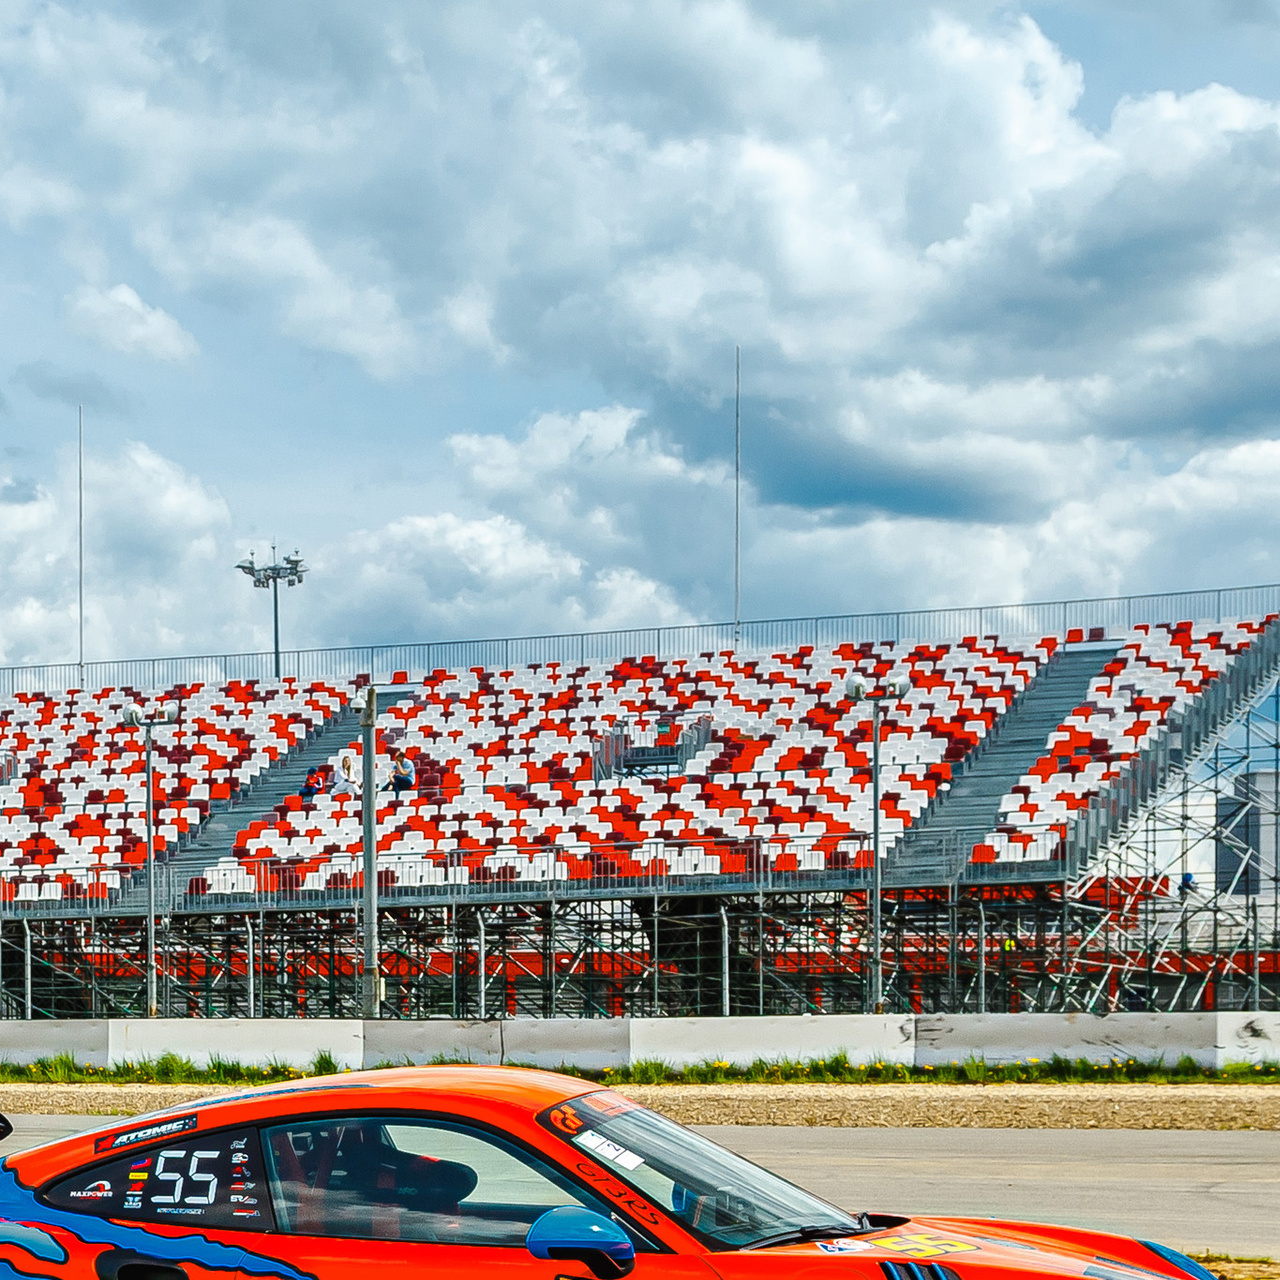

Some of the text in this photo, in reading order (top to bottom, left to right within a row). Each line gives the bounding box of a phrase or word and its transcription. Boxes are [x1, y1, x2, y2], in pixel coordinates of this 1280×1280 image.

[114, 1120, 185, 1144] ATOMIC
[150, 1150, 220, 1205] 55
[576, 1163, 665, 1225] GT3RS
